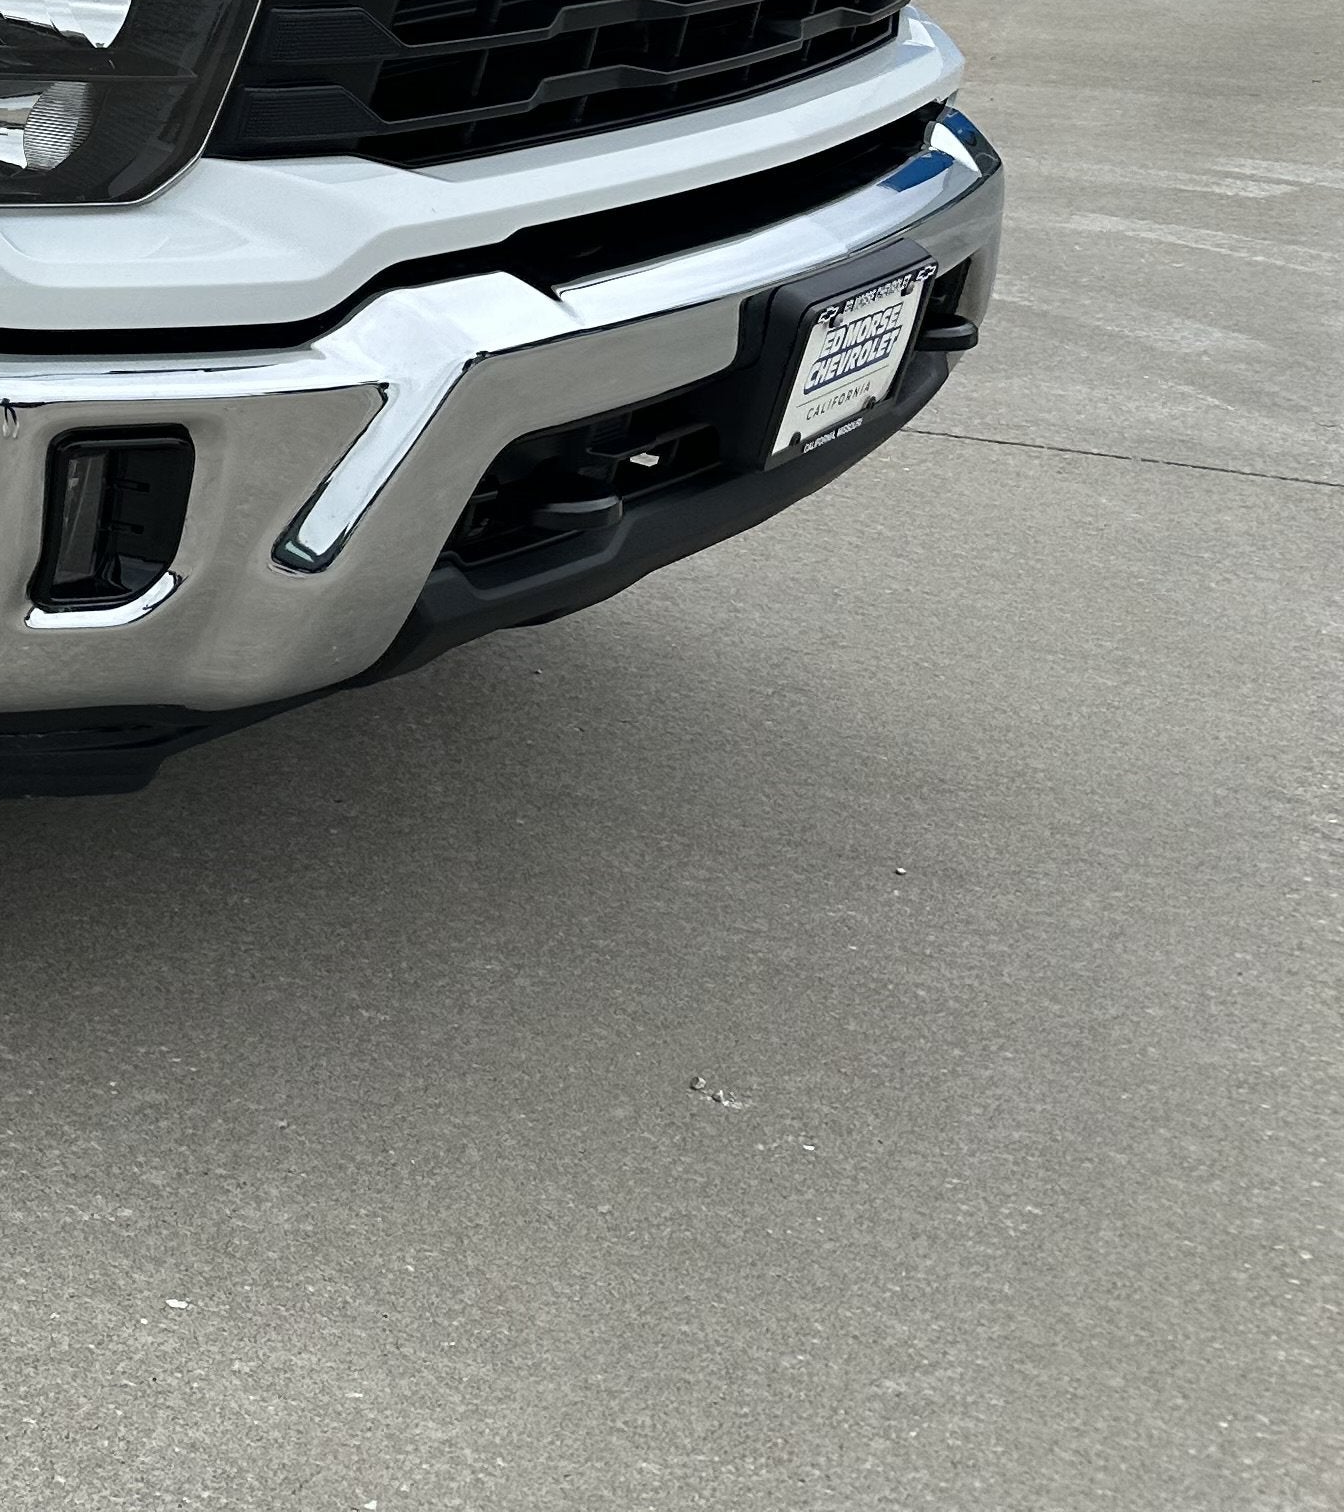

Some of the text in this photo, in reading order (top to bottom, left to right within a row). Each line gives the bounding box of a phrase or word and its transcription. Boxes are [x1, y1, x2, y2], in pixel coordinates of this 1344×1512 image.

[822, 304, 903, 356] ED MORSE
[804, 326, 902, 390] CHEVROLET
[806, 381, 871, 420] CALIFORNIA
